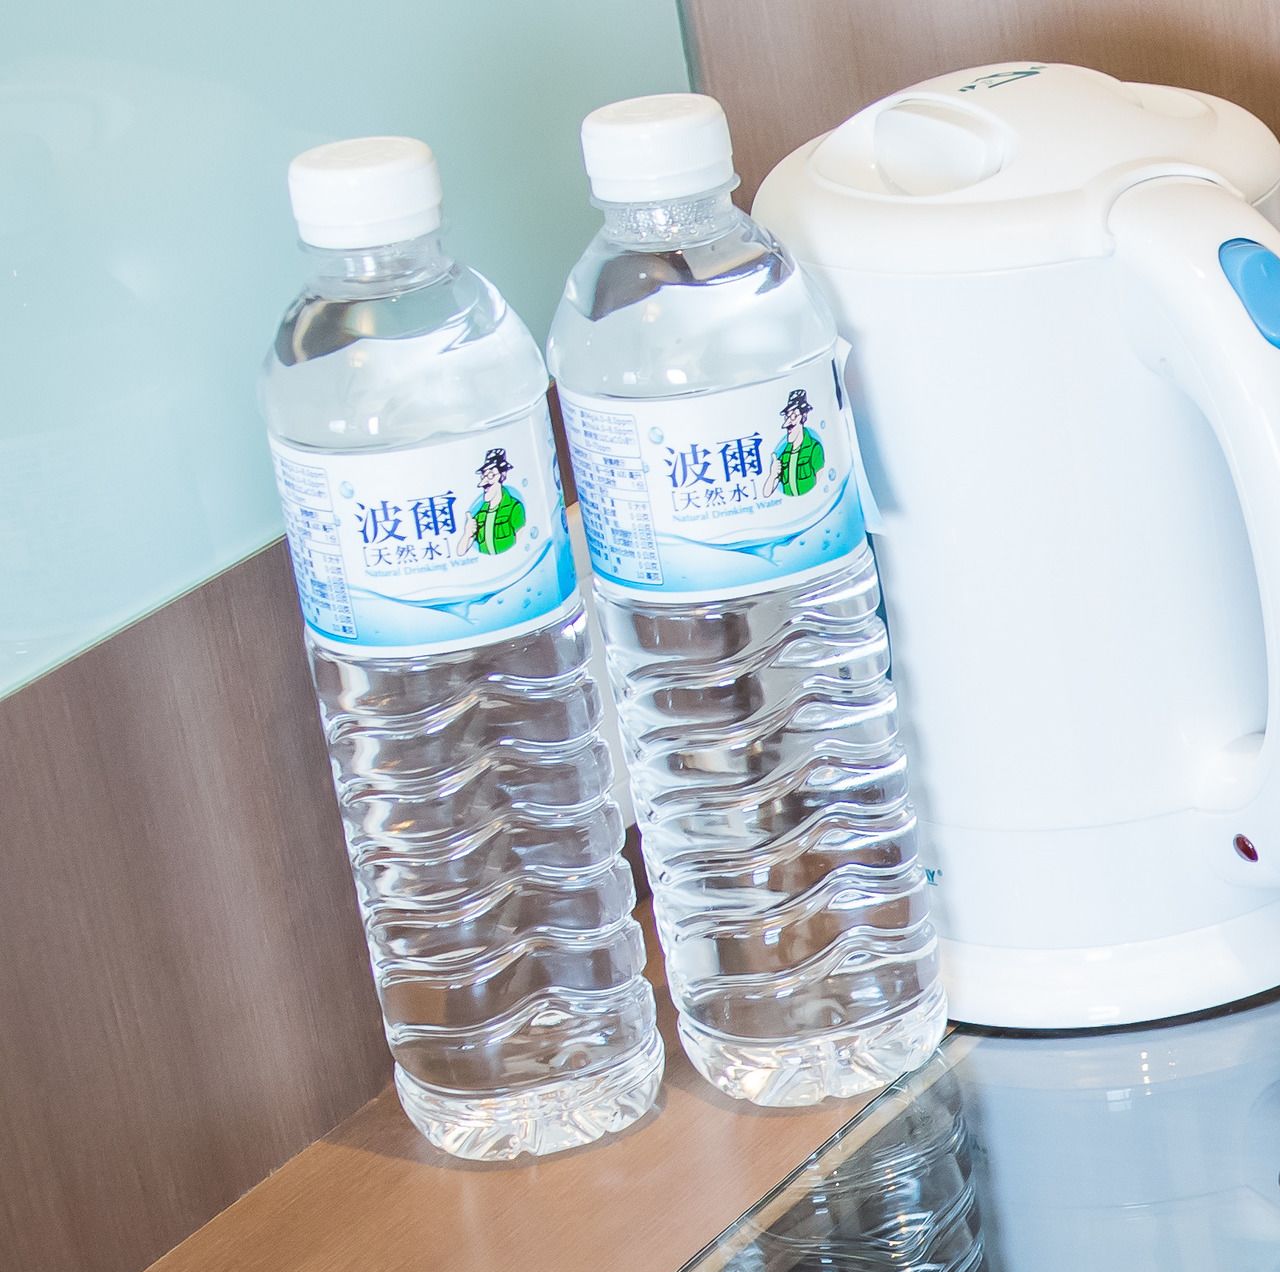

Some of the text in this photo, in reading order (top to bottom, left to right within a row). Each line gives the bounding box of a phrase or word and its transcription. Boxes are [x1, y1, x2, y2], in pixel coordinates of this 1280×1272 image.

[663, 432, 763, 488] 波爾
[353, 490, 457, 544] 波爾
[711, 504, 754, 519] Drinking
[756, 498, 783, 510] Water
[404, 562, 448, 576] Drinking
[450, 556, 480, 568] Water
